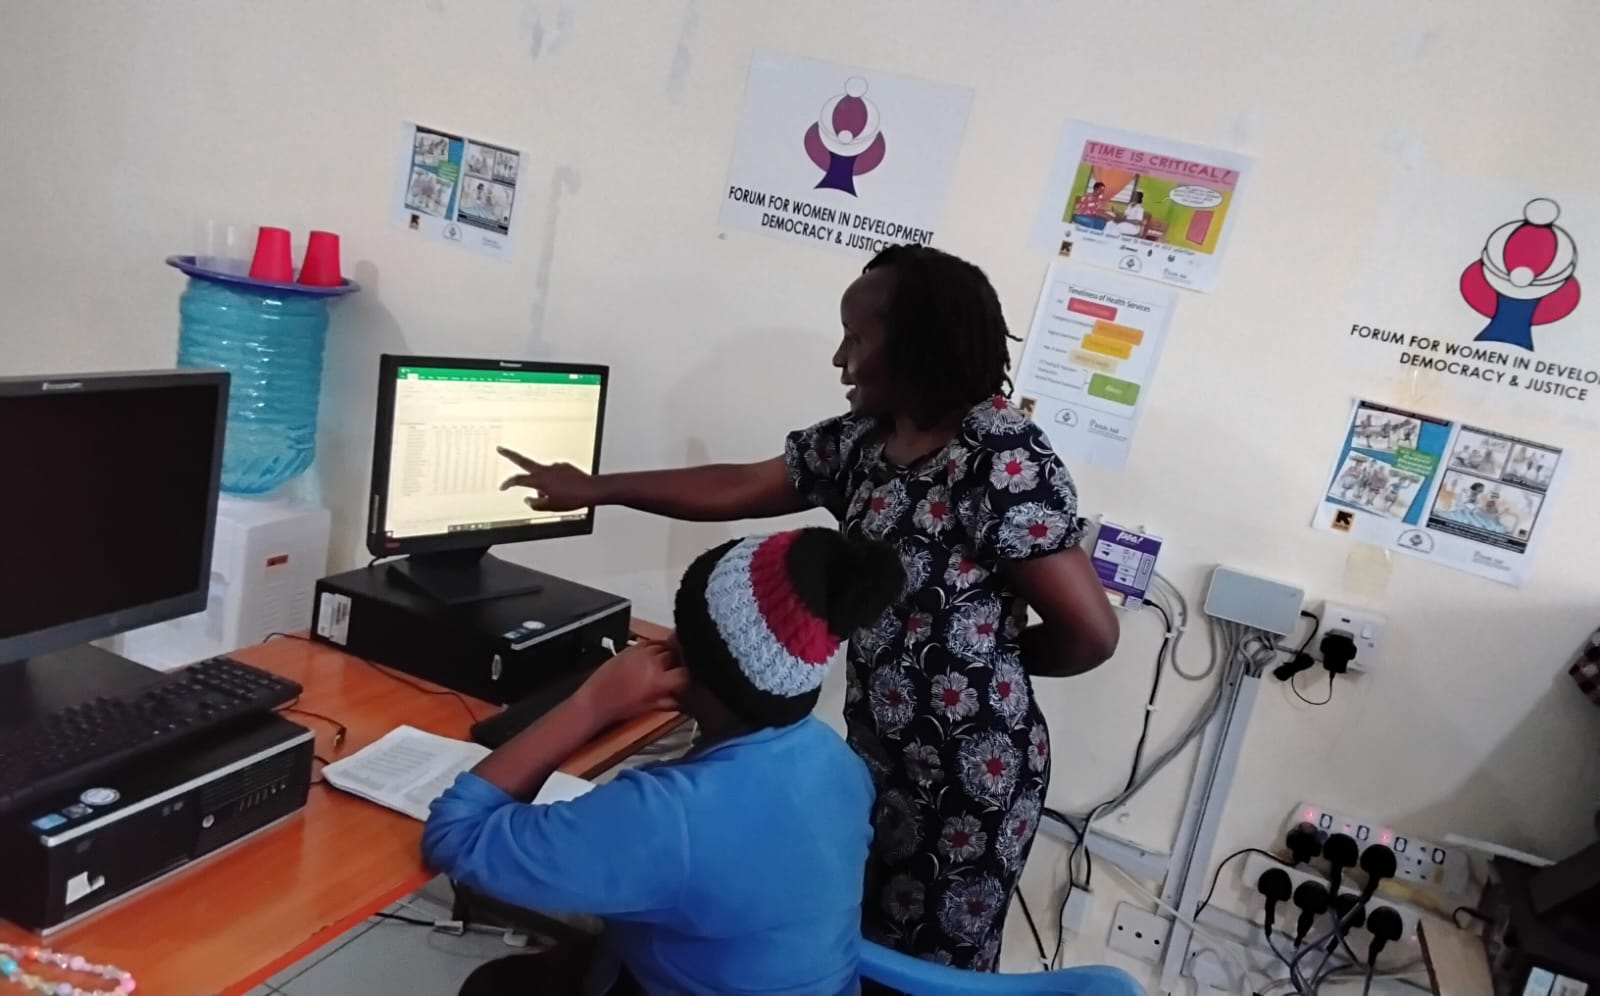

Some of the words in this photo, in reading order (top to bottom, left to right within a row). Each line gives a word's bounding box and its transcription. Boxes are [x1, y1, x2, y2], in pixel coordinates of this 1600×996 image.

[1088, 142, 1125, 161] TIME
[1130, 150, 1146, 163] IS
[728, 186, 766, 207] FORUM
[768, 196, 790, 213] FOR
[792, 200, 837, 222] WOMEN
[838, 211, 851, 227] IN
[853, 214, 934, 246] DEVELOPMENT
[761, 213, 833, 242] DEMOCRACY
[834, 232, 842, 245] &
[1127, 299, 1151, 313] Services
[1350, 324, 1404, 346] FORUM
[1408, 335, 1441, 352] FOR
[1444, 342, 1510, 367] WOMEN
[1512, 355, 1531, 371] IN
[1534, 361, 1600, 385] DEVELO
[1400, 352, 1506, 384] DEMOCRACY
[1508, 374, 1519, 387] &
[1525, 378, 1589, 401] JUSTICE
